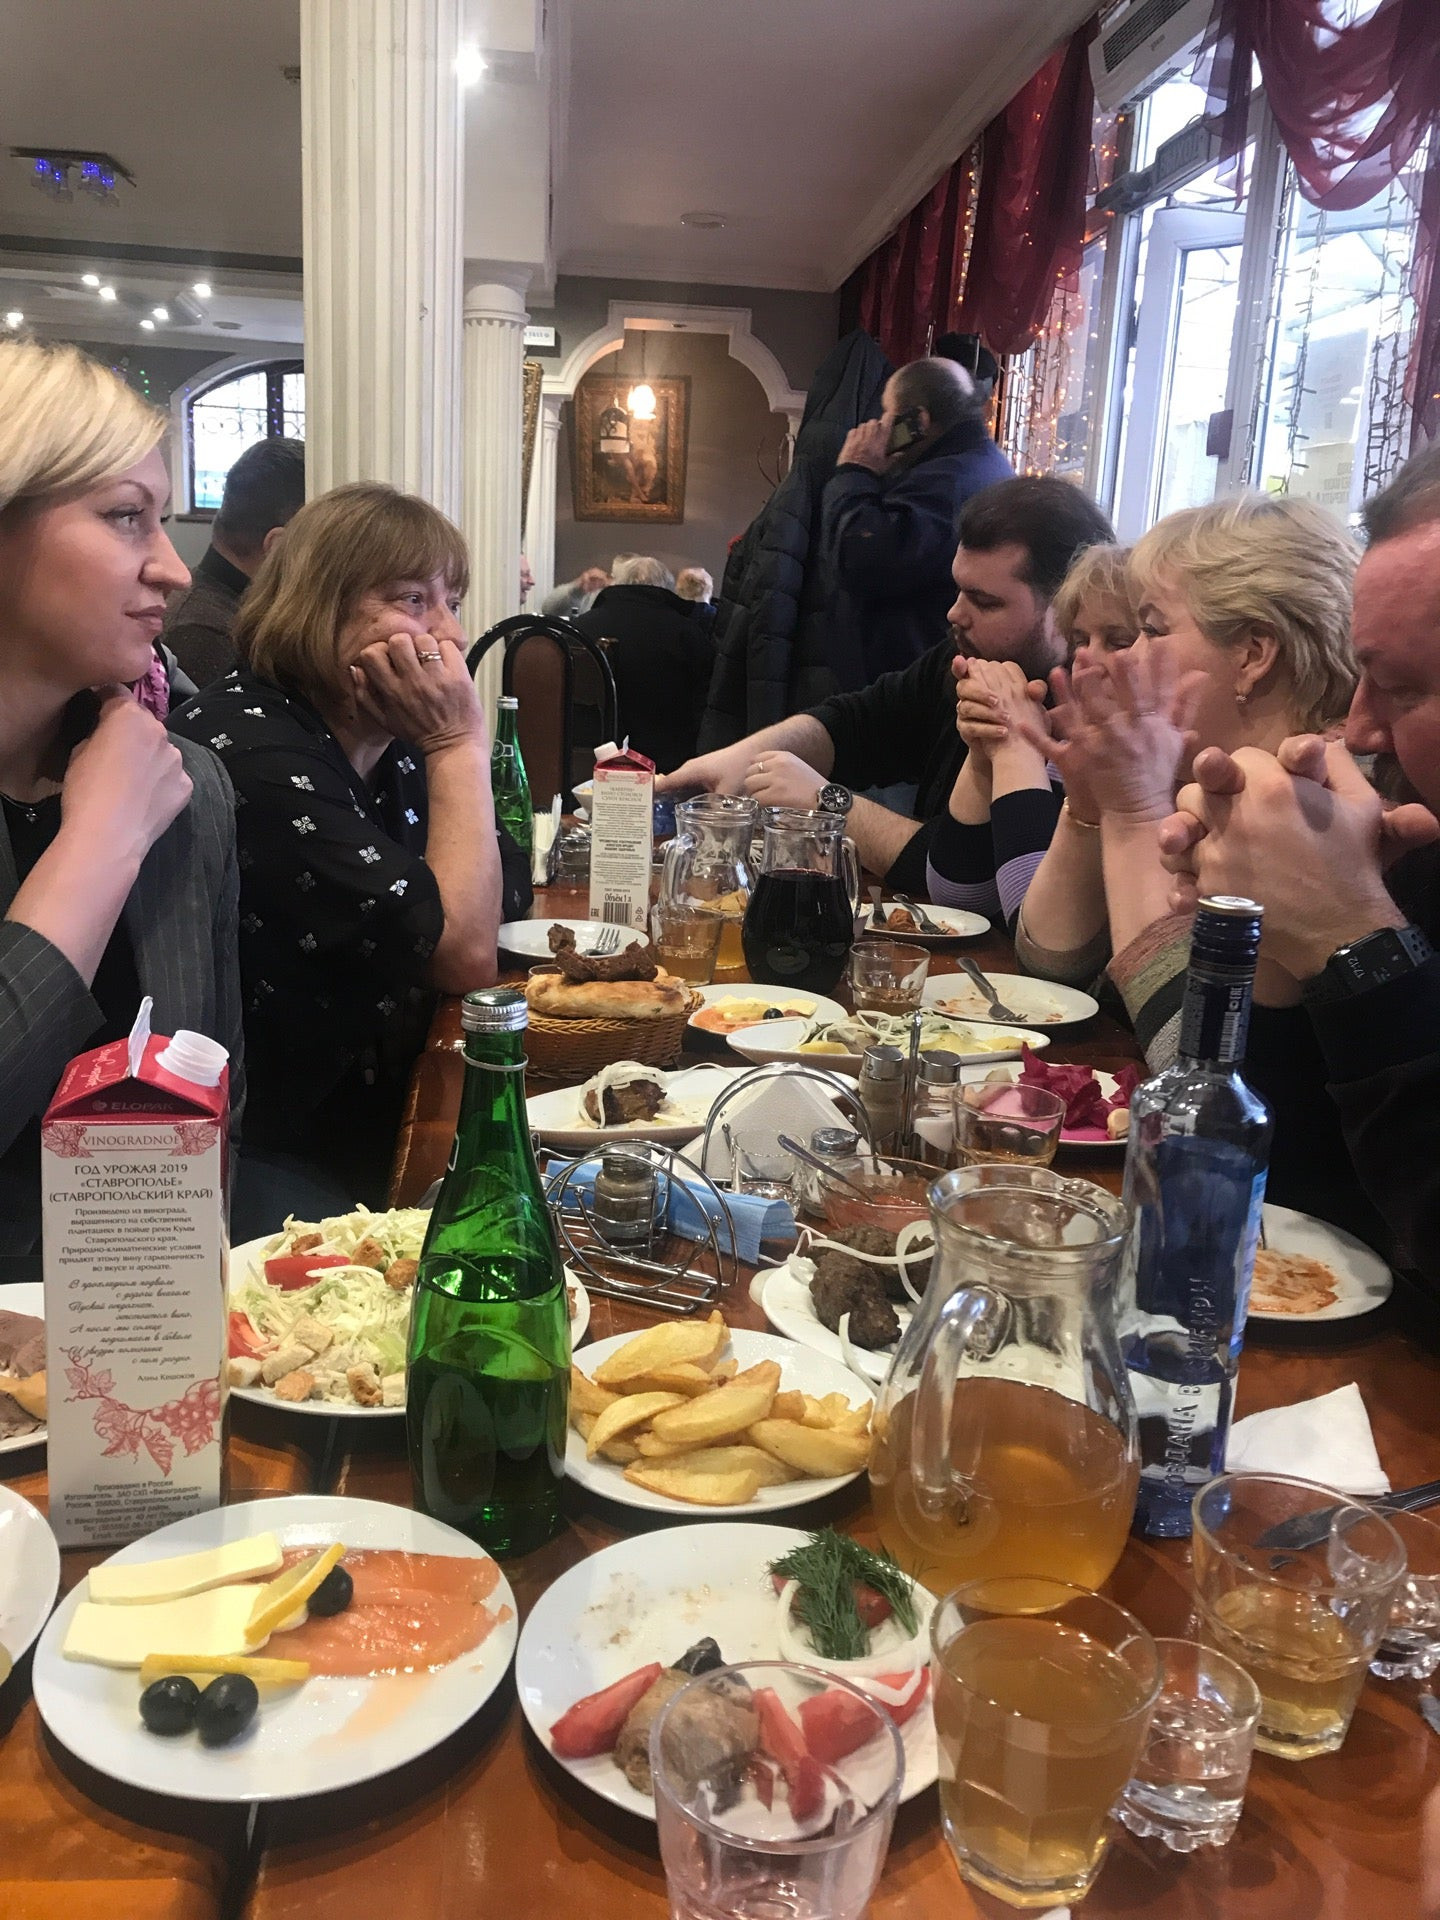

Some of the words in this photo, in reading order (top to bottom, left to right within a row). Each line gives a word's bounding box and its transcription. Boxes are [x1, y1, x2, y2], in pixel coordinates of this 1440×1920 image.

[111, 1101, 174, 1111] ELOPAK
[82, 1135, 180, 1146] VINOGRADNOE
[74, 1165, 101, 1175] ГОД
[104, 1164, 157, 1174] УРОЖАЯ
[160, 1163, 188, 1174] 2019
[80, 1177, 183, 1189] «СТАВРОПОЛЬЕ»
[49, 1189, 174, 1203] (СТАВРОПОЛЬСКИЙ
[177, 1188, 213, 1200] КРАЙ)
